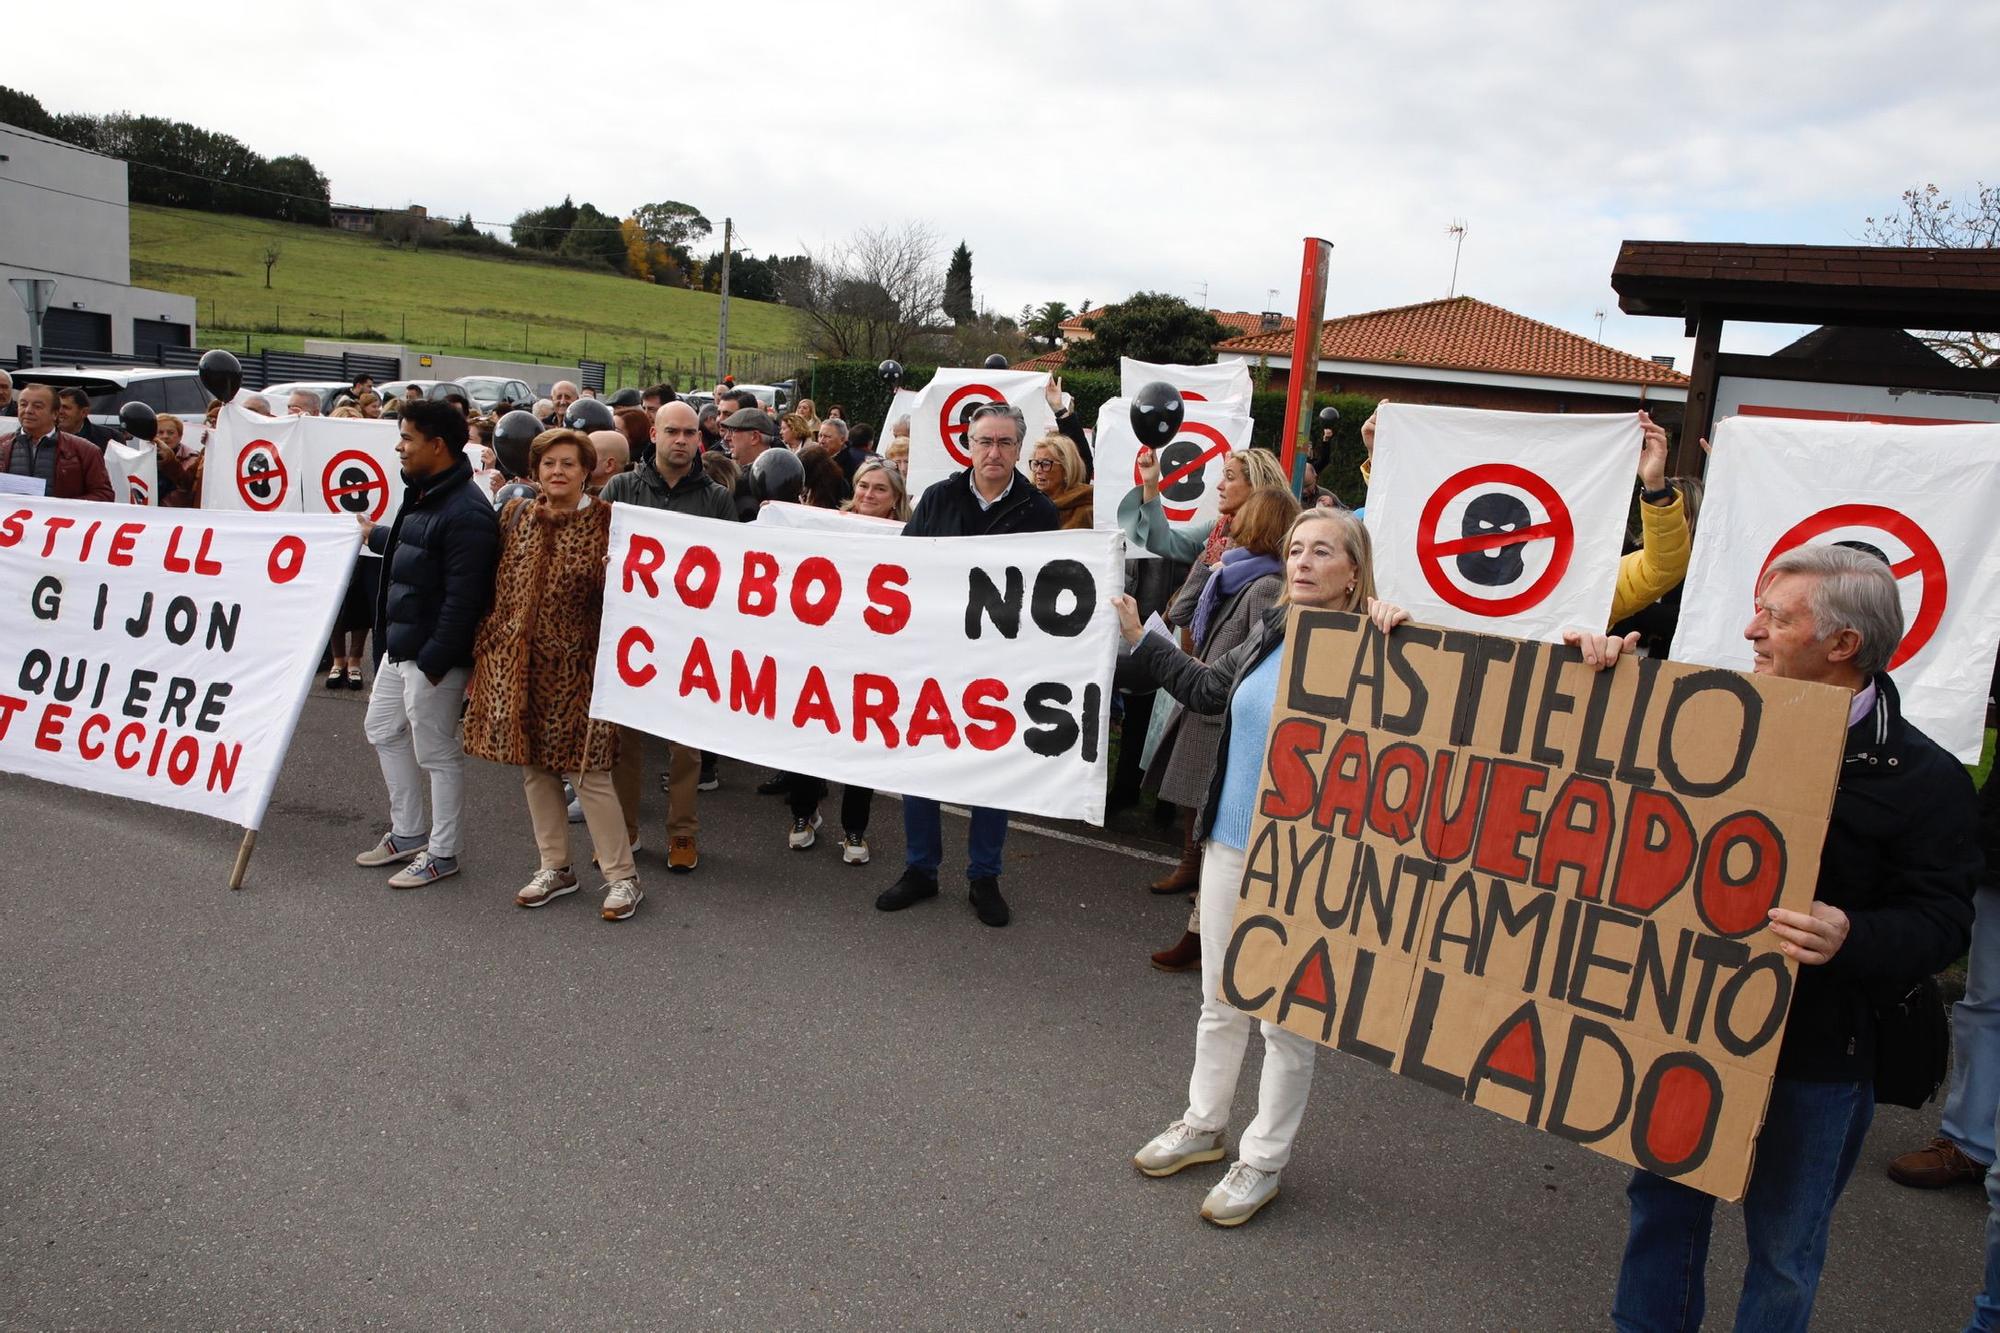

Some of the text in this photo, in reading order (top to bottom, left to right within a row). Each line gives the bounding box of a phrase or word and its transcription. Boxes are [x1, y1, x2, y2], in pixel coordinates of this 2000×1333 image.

[32, 575, 242, 652] GIJON
[622, 533, 1097, 640] ROBOS NO
[0, 694, 243, 794] TECCION
[18, 648, 234, 733] QUIERE
[616, 625, 1101, 763] CAMARAS SI
[1287, 610, 1762, 798] CASTIELLO
[1260, 717, 1788, 938] SAQUEADO
[1240, 820, 1793, 1058] AYUNTAMIENTO
[1222, 914, 1724, 1178] CALLADO
